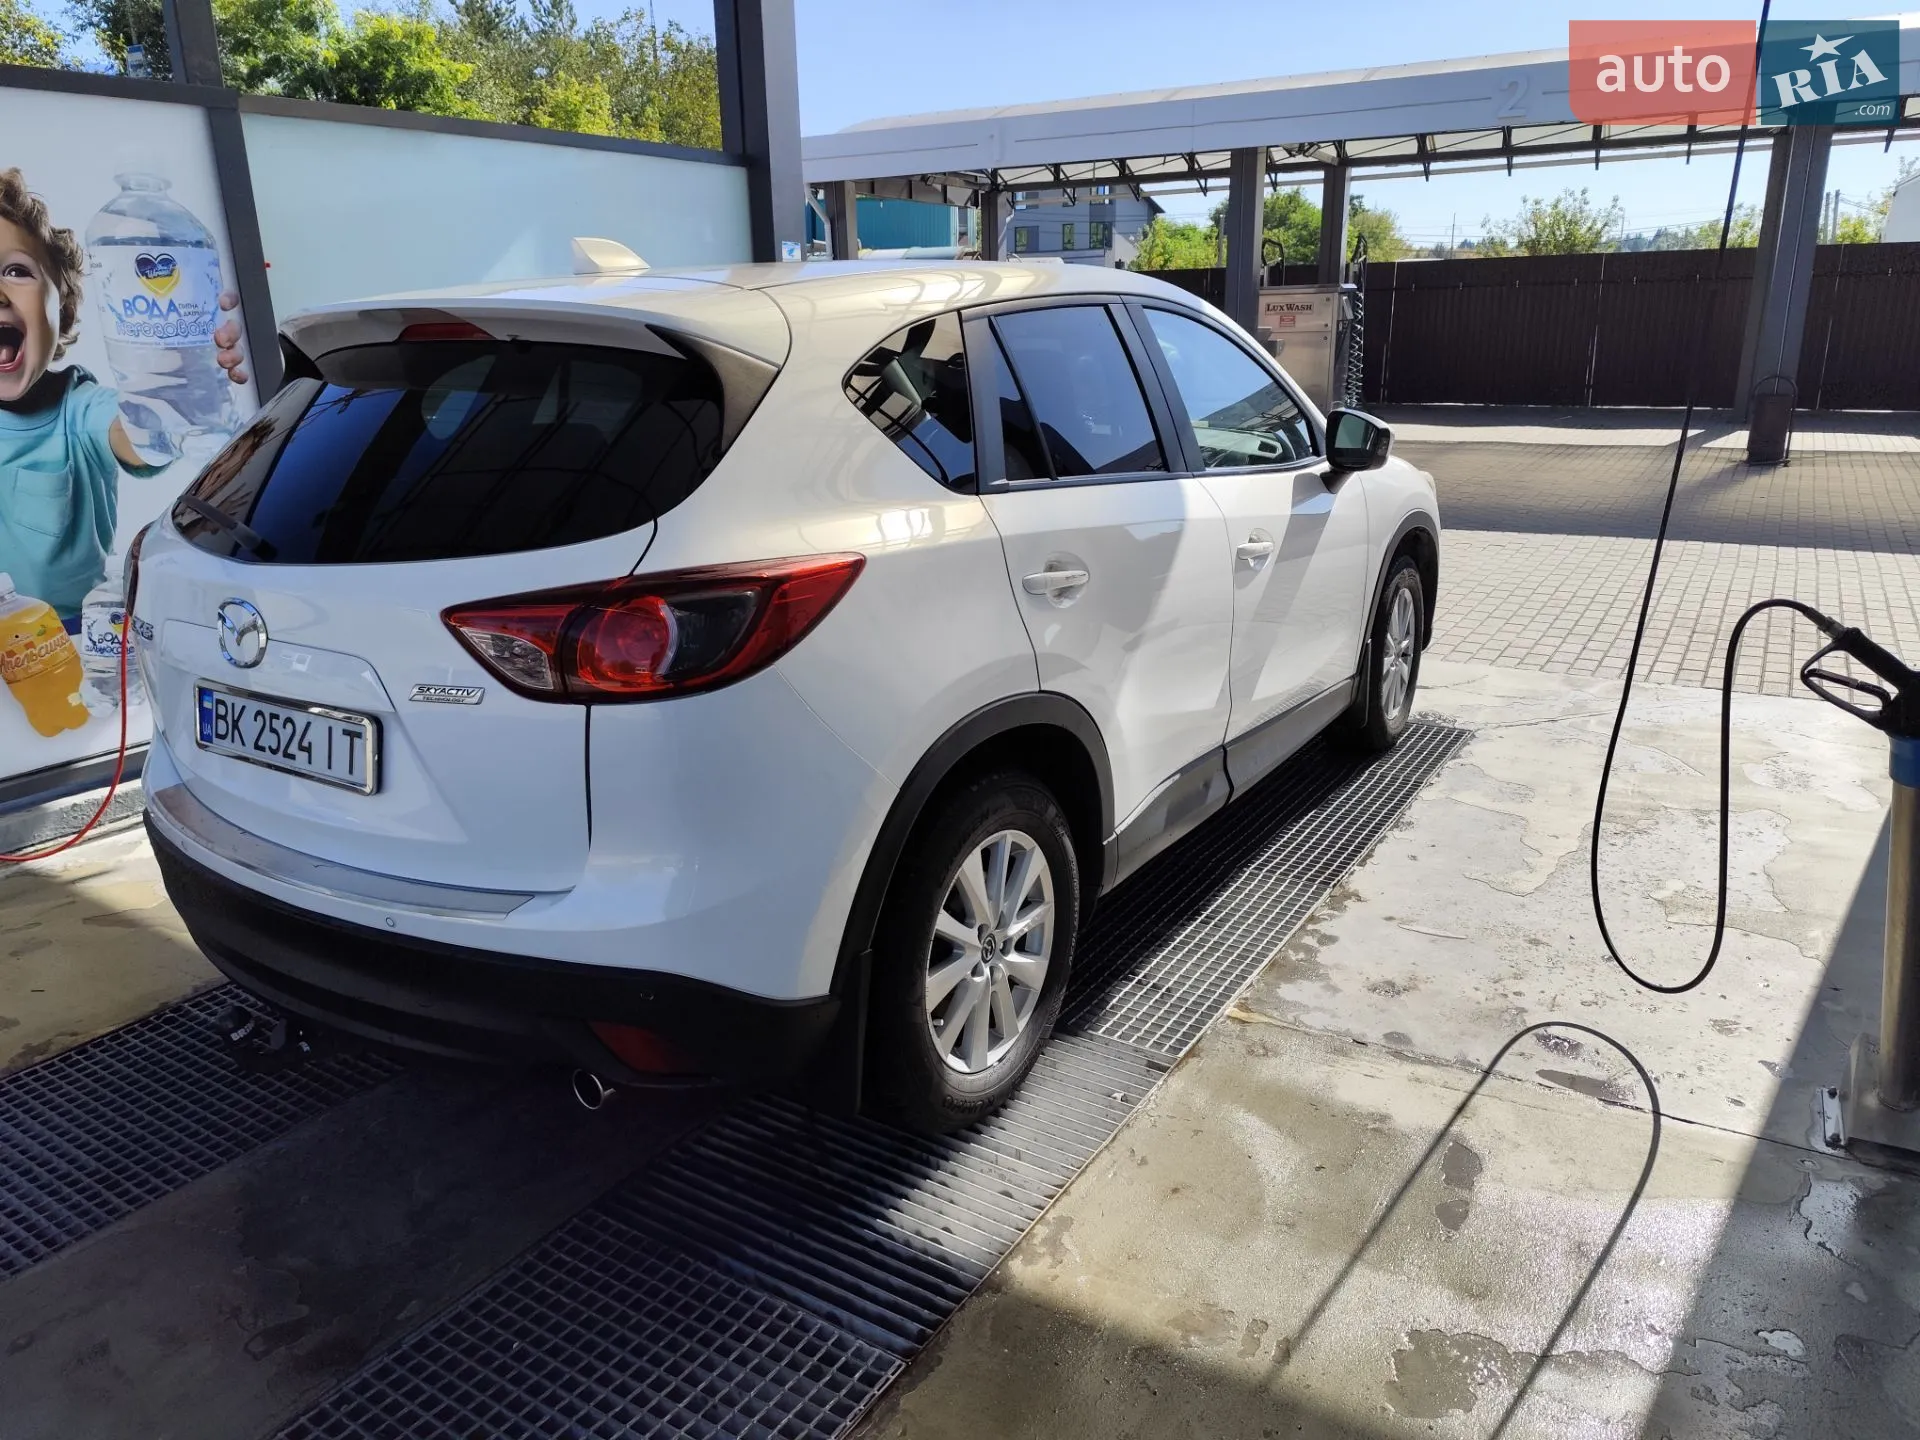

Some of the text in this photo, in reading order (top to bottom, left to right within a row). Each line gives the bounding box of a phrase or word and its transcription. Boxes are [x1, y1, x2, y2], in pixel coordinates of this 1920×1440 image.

[1497, 72, 1530, 119] 2
[122, 295, 182, 320] ВОДА
[416, 686, 476, 696] SKYACTIV
[202, 721, 212, 736] UA
[214, 698, 363, 775] BK 2524 IT
